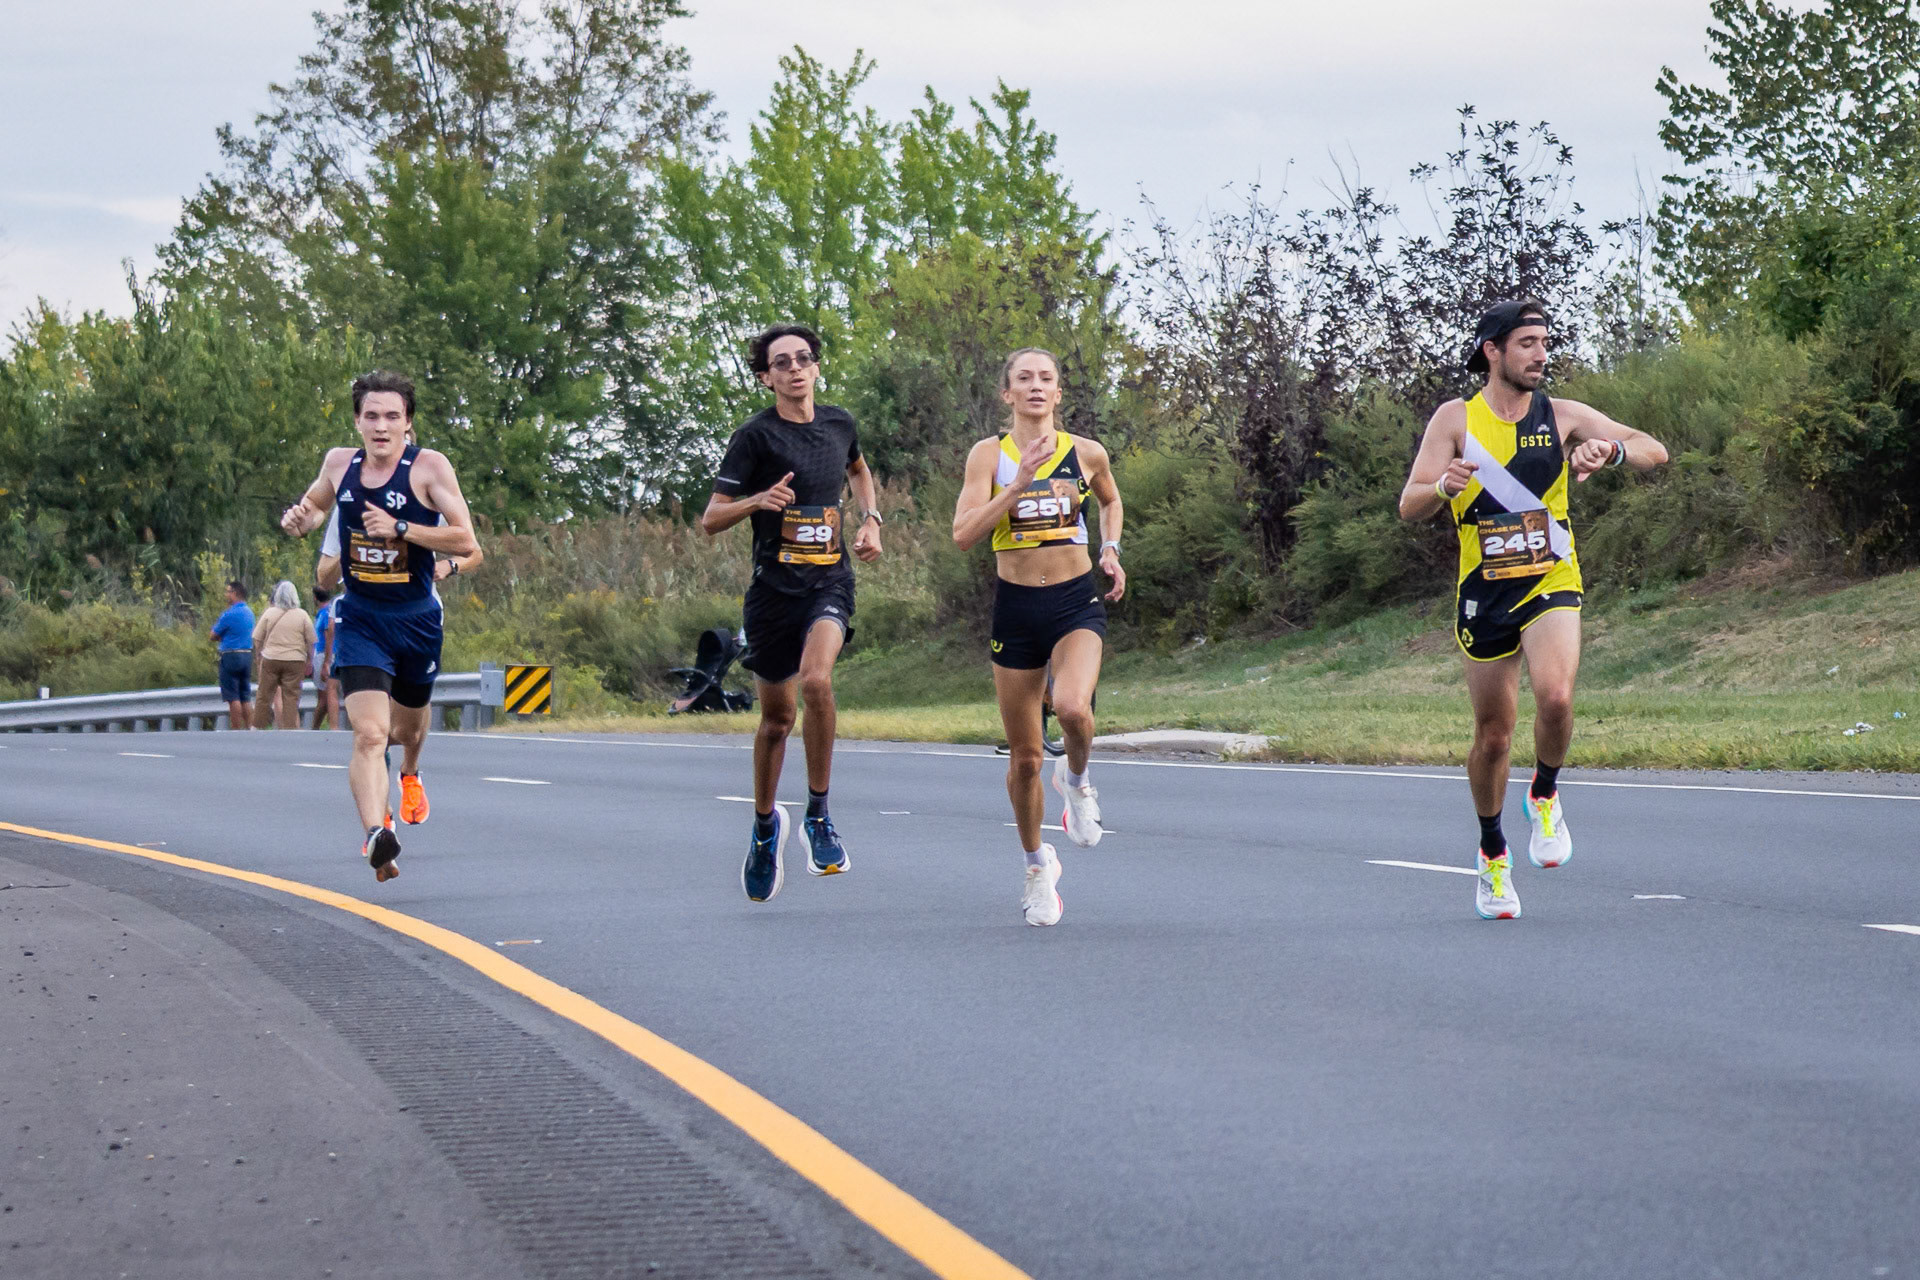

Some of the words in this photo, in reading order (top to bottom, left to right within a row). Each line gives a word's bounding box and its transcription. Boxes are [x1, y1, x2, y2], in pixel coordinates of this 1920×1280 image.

[1520, 434, 1552, 448] GSTC
[1017, 497, 1071, 519] 251
[796, 525, 833, 542] 29
[1479, 526, 1509, 534] CHASE
[1484, 530, 1546, 555] 245
[357, 546, 399, 564] 137
